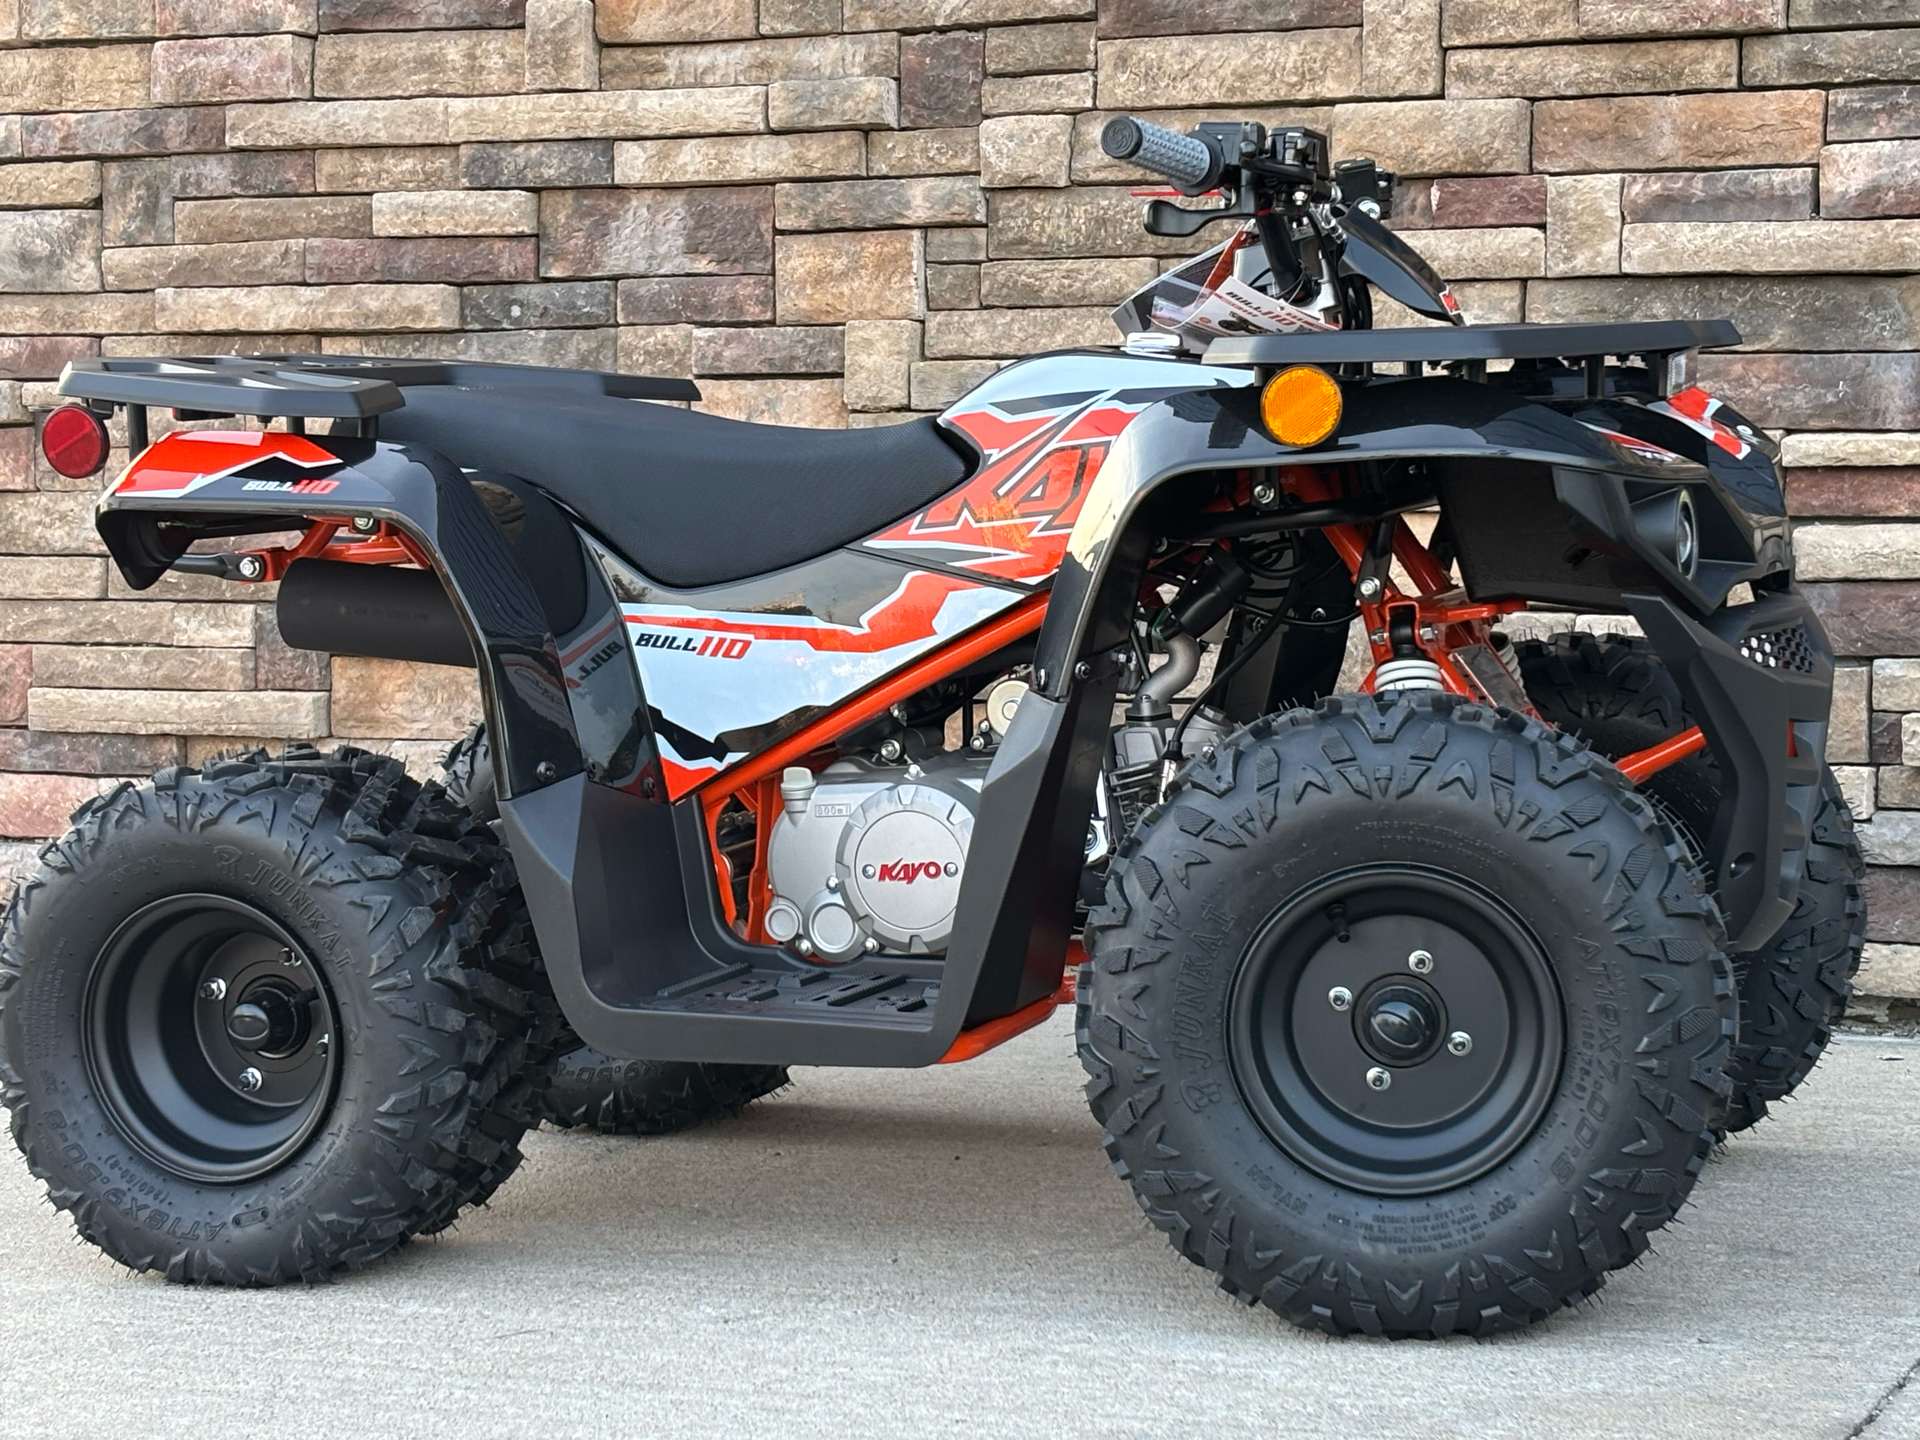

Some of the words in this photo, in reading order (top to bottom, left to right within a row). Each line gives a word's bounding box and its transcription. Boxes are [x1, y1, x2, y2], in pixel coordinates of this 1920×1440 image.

[878, 857, 942, 885] KAYO
[245, 860, 354, 974] JUNKAI
[1172, 903, 1238, 1069] JUNKAI
[1246, 1164, 1309, 1215] NYLON
